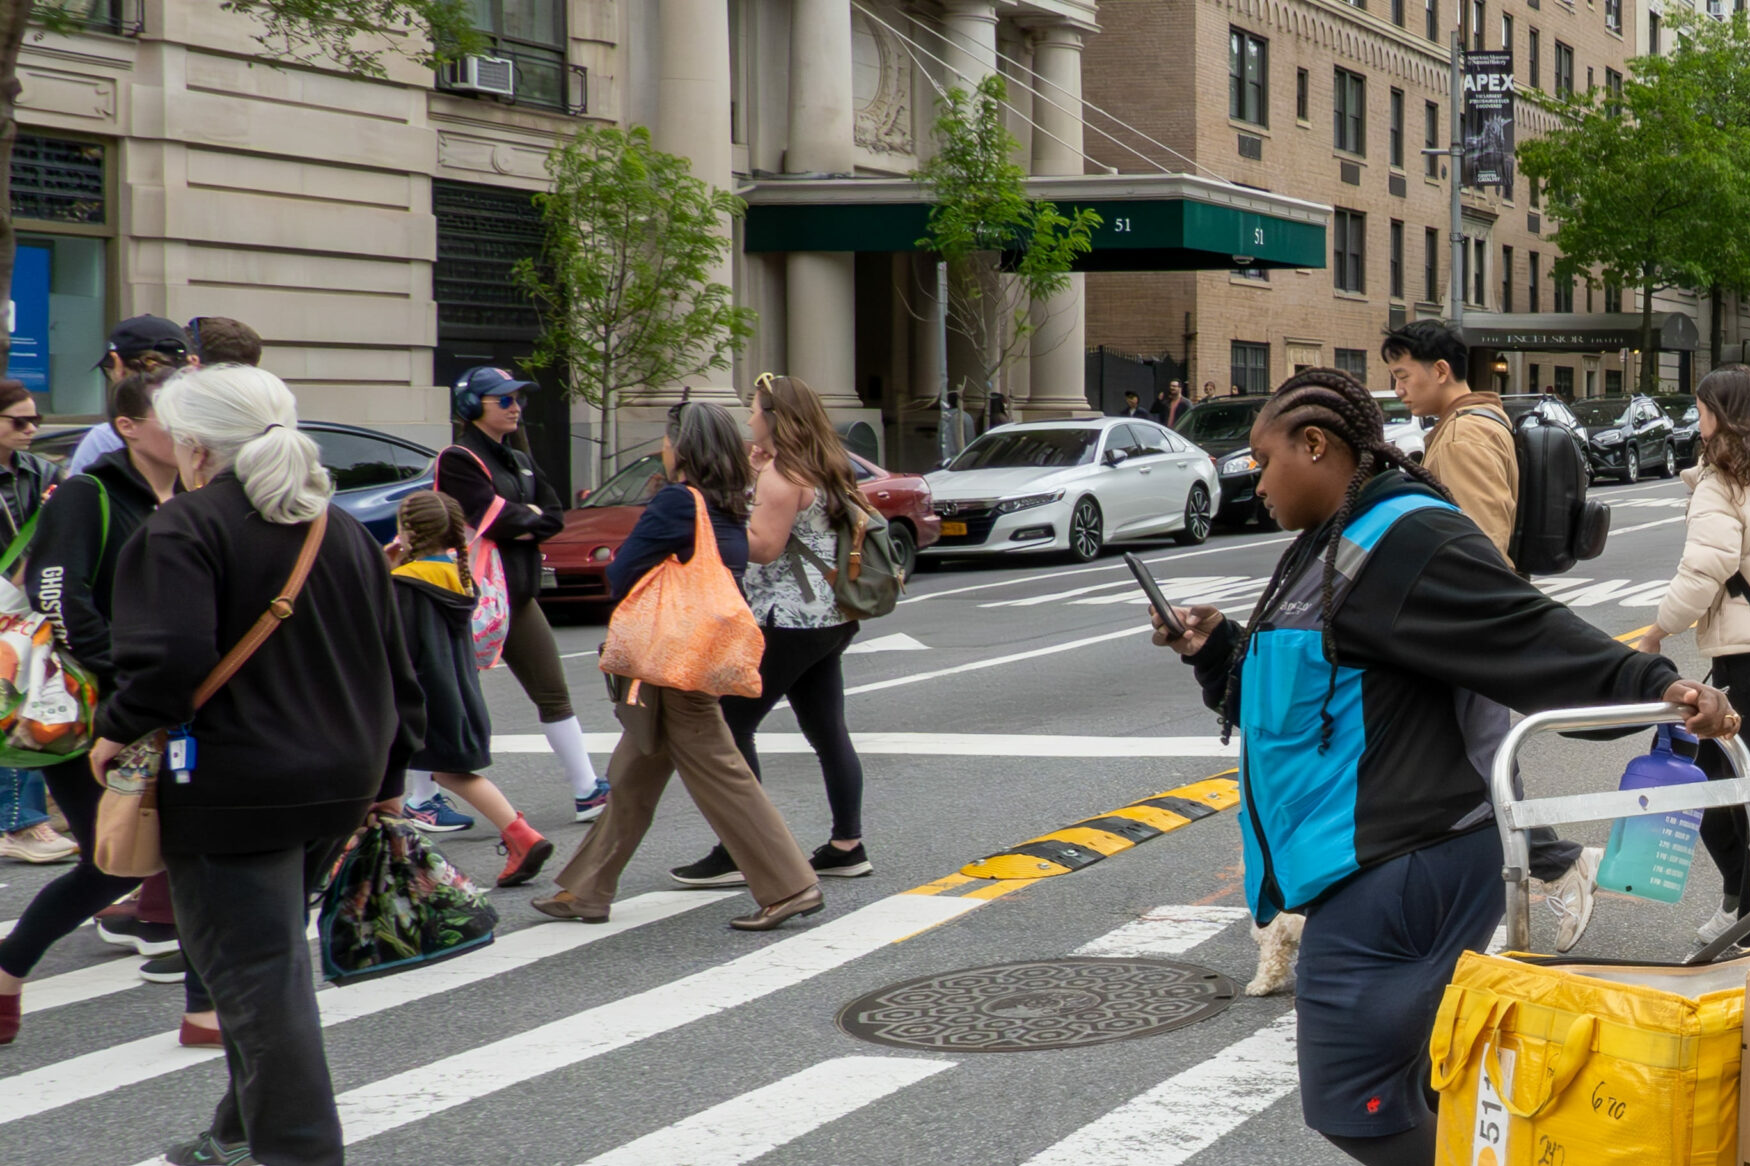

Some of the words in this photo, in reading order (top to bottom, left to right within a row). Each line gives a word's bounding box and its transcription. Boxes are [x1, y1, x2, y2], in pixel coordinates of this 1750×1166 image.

[1464, 74, 1514, 92] APEX
[1114, 218, 1132, 232] 51
[1254, 228, 1265, 245] 51
[1507, 335, 1585, 344] EXCELSIOR
